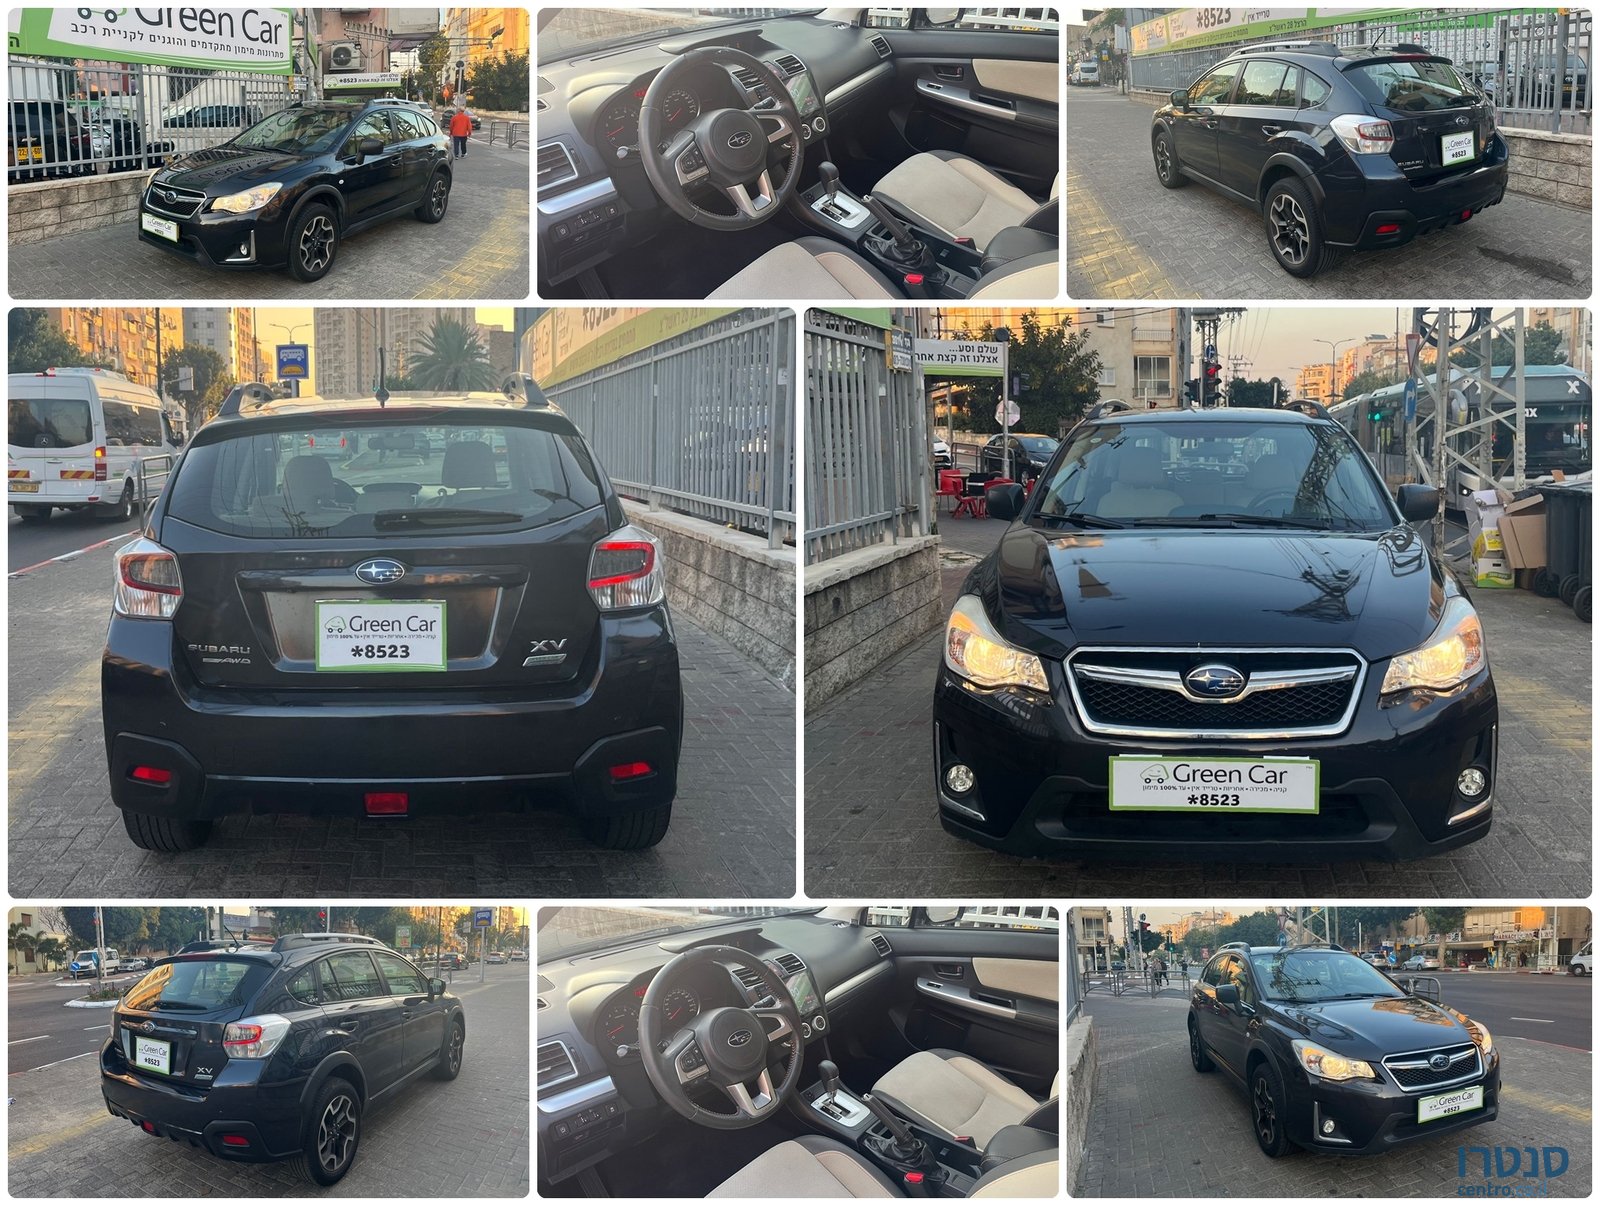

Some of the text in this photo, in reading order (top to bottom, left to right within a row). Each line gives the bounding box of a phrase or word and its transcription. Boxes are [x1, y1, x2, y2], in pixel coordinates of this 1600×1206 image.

[242, 9, 282, 44] Car
[71, 23, 284, 59] פתרונות מימון מתקדמים והוגנים לקניית רכב
[949, 344, 998, 354] שלם וסע...
[937, 354, 957, 364] קצת
[960, 354, 970, 362] זה
[973, 354, 998, 364] אצלנו
[349, 615, 437, 632] Green Car
[188, 644, 250, 654] SUBARU
[530, 638, 567, 652] XV
[1173, 764, 1288, 784] Green Car
[144, 1044, 158, 1054] Green
[159, 1048, 167, 1056] Car
[1438, 1092, 1474, 1106] Green Car
